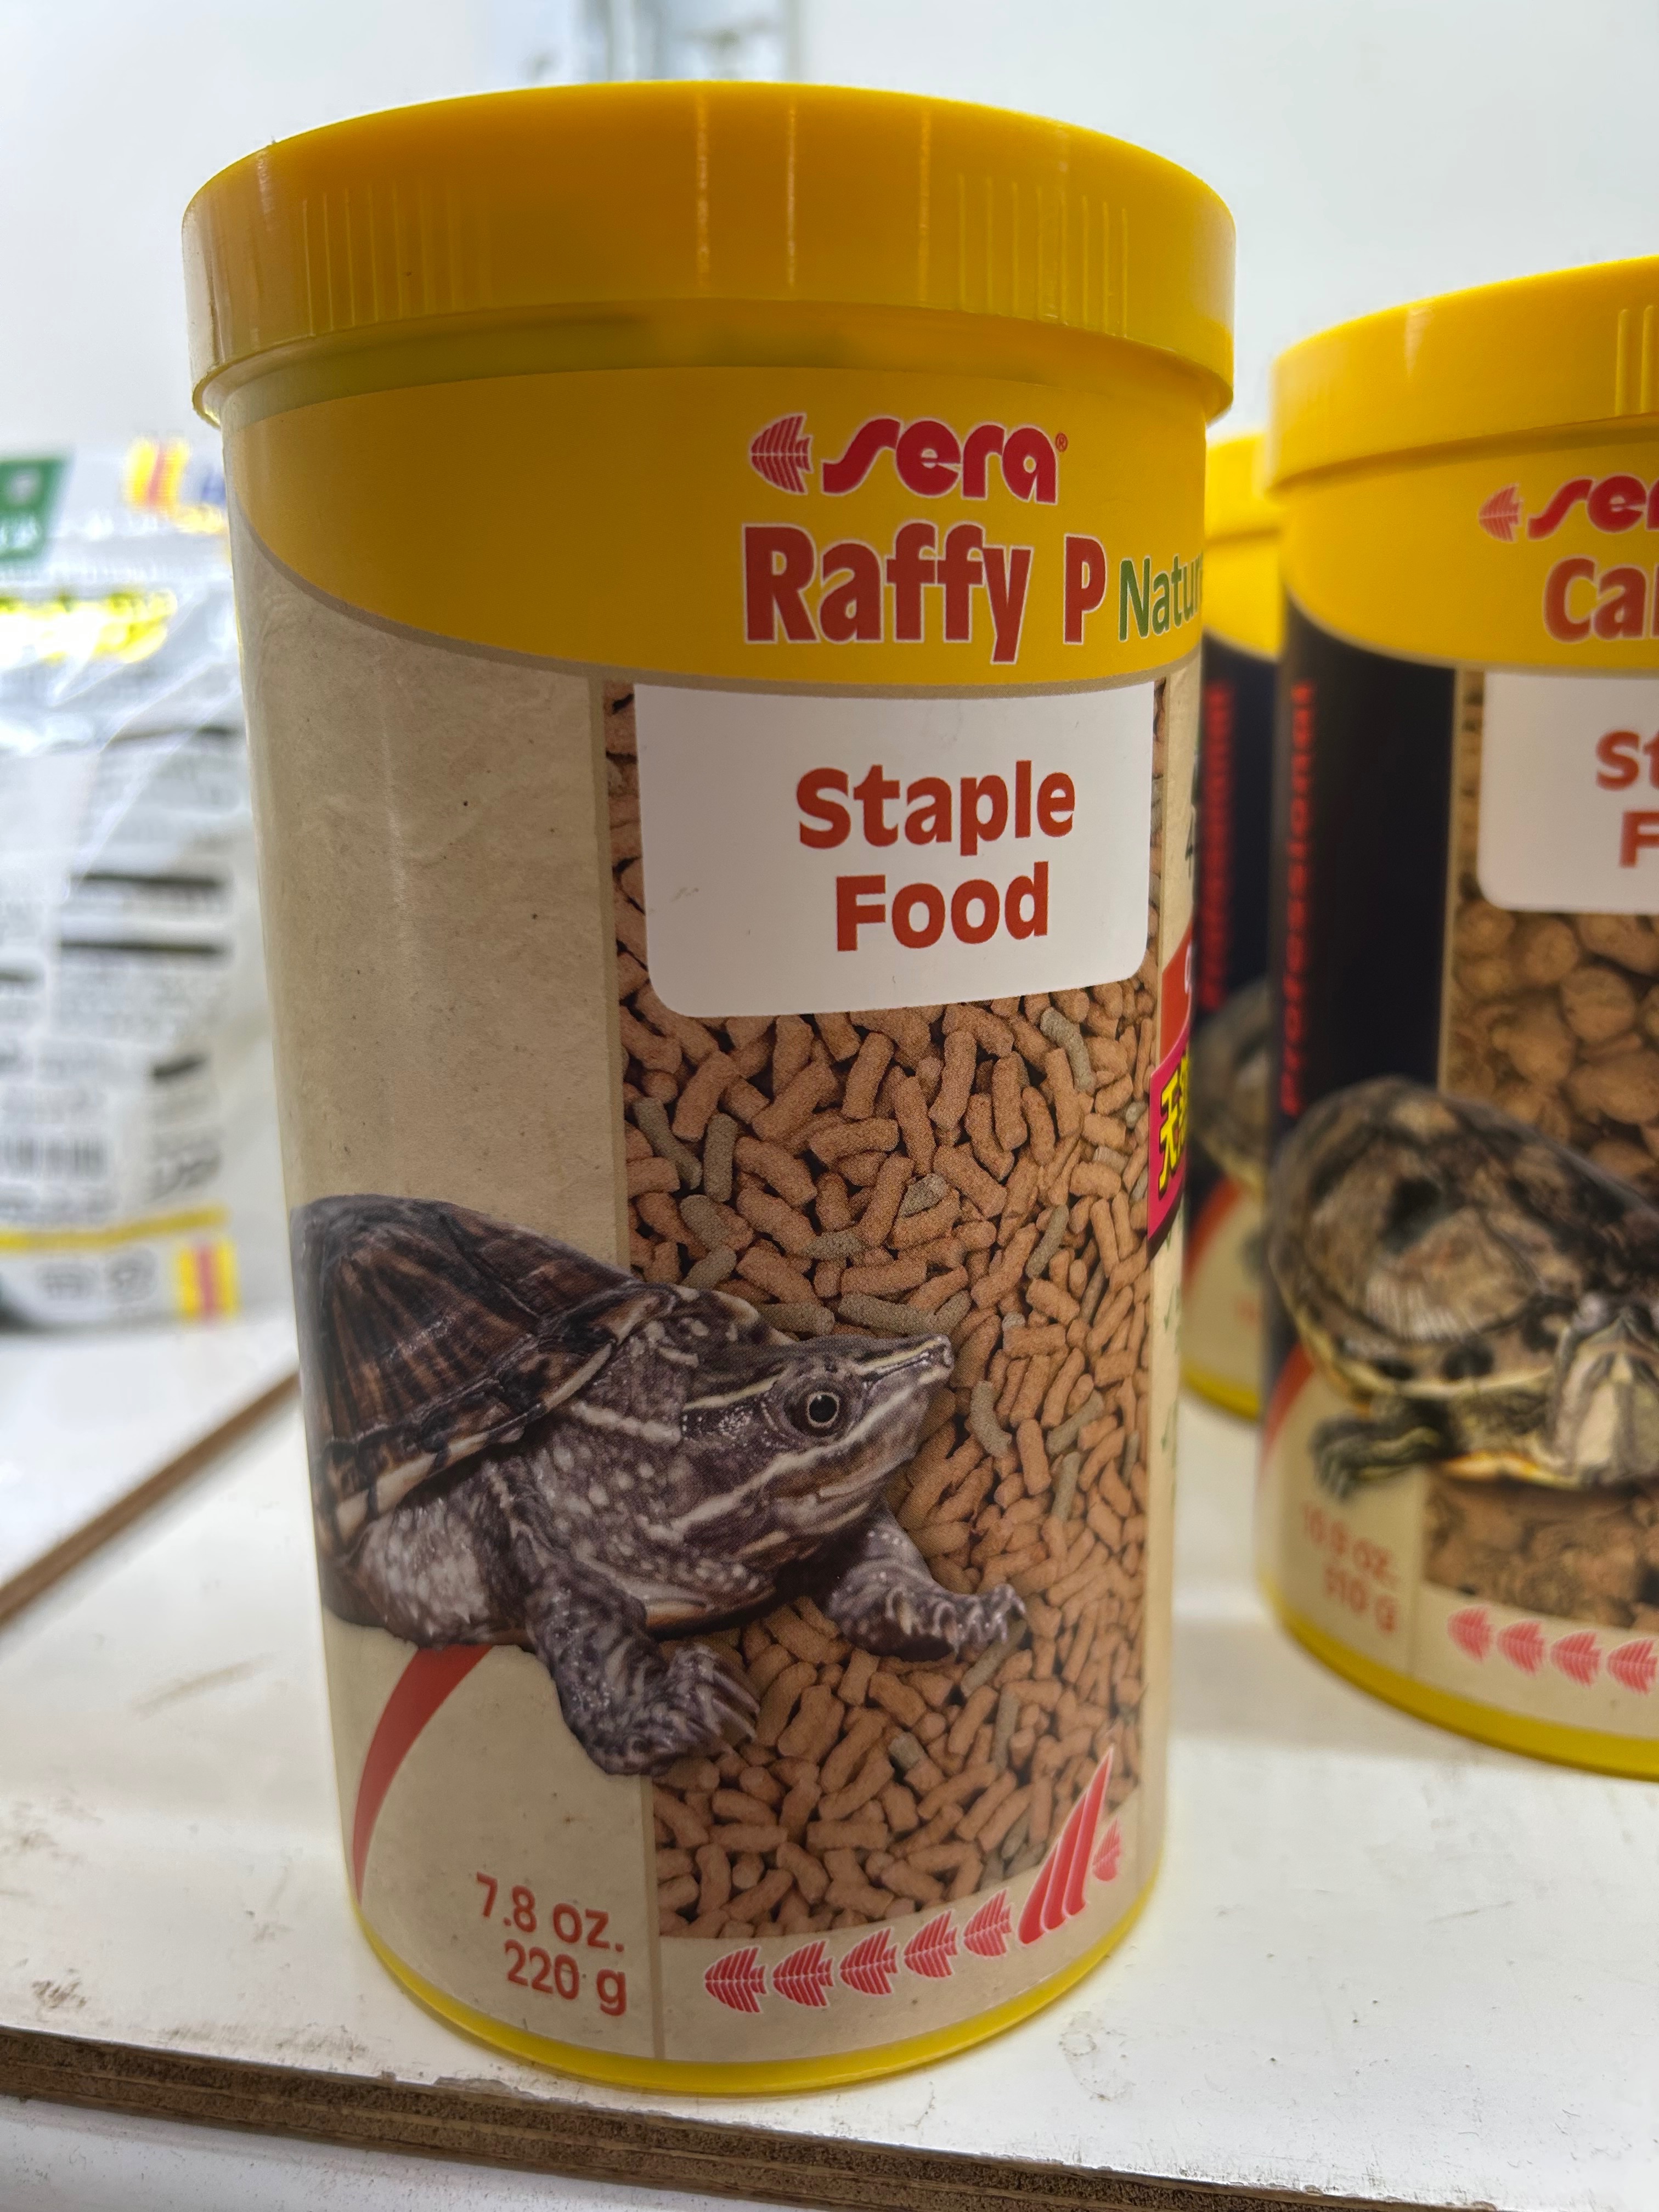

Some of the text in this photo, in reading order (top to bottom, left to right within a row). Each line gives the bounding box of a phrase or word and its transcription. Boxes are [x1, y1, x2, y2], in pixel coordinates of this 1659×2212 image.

[743, 520, 1032, 664] Raffy
[1063, 534, 1107, 644] P
[1543, 555, 1659, 644] Ca
[795, 760, 1076, 856] Staple
[836, 861, 1049, 952] Food
[476, 1871, 537, 1933] 7.8
[504, 1939, 627, 2016] 220 g
